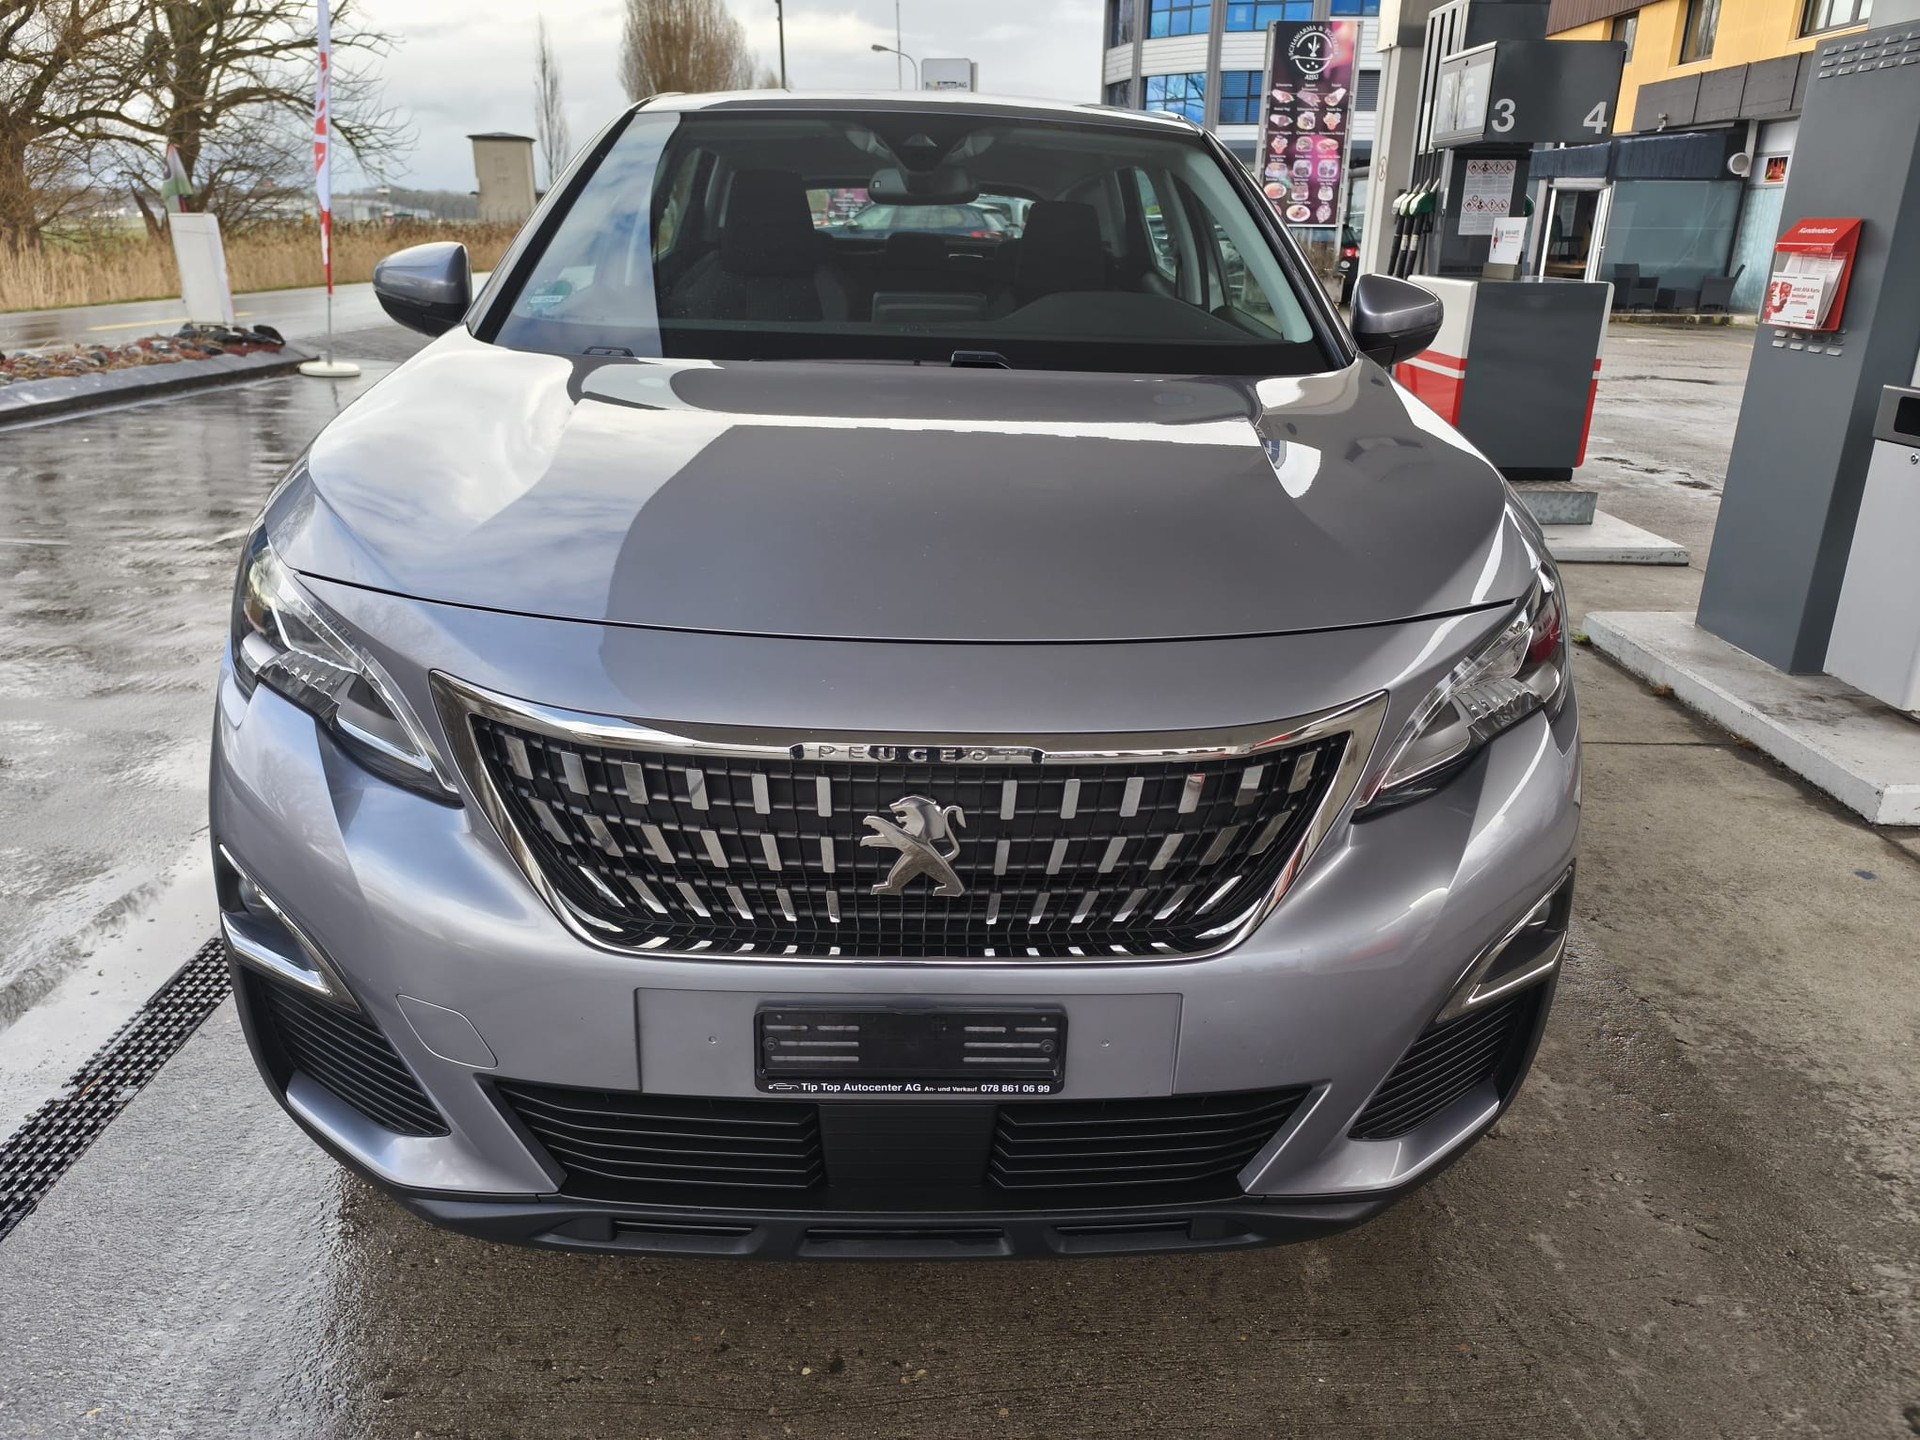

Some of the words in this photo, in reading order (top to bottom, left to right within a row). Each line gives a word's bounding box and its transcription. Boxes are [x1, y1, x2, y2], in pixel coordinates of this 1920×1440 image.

[1491, 98, 1516, 133] 3
[1582, 101, 1608, 135] 4
[817, 744, 1018, 762] PEUGEOT
[801, 1083, 818, 1093] Tip
[820, 1083, 841, 1093] Top
[843, 1083, 902, 1092] Autocenter
[904, 1084, 922, 1092] AG
[980, 1084, 999, 1093] 078
[1001, 1084, 1019, 1093] 861
[1022, 1084, 1035, 1093] 06
[1037, 1085, 1050, 1093] 99
